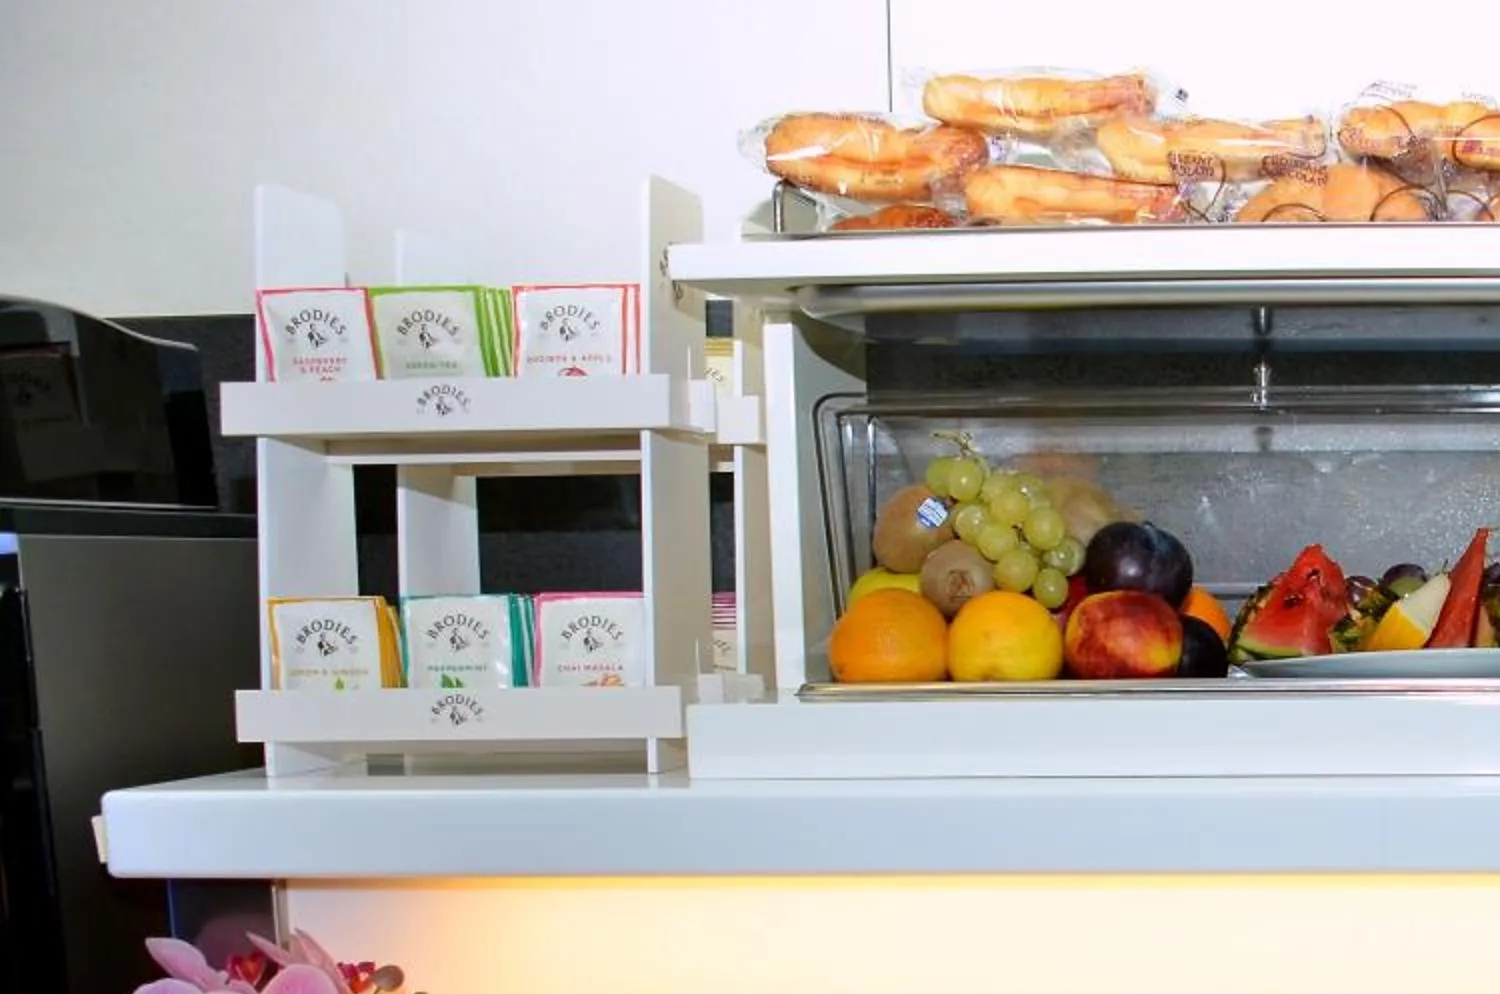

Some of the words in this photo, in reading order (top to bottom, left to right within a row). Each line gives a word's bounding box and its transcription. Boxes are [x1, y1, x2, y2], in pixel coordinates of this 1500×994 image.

[285, 308, 348, 337] BRODIES
[396, 309, 460, 338] BRODIES
[540, 303, 601, 331] BRODIES
[416, 384, 472, 409] BRODIES
[296, 618, 359, 646] BRODIES
[426, 612, 490, 641] BRODIES
[561, 615, 624, 642] BRODIES
[431, 693, 484, 716] BRODIES
